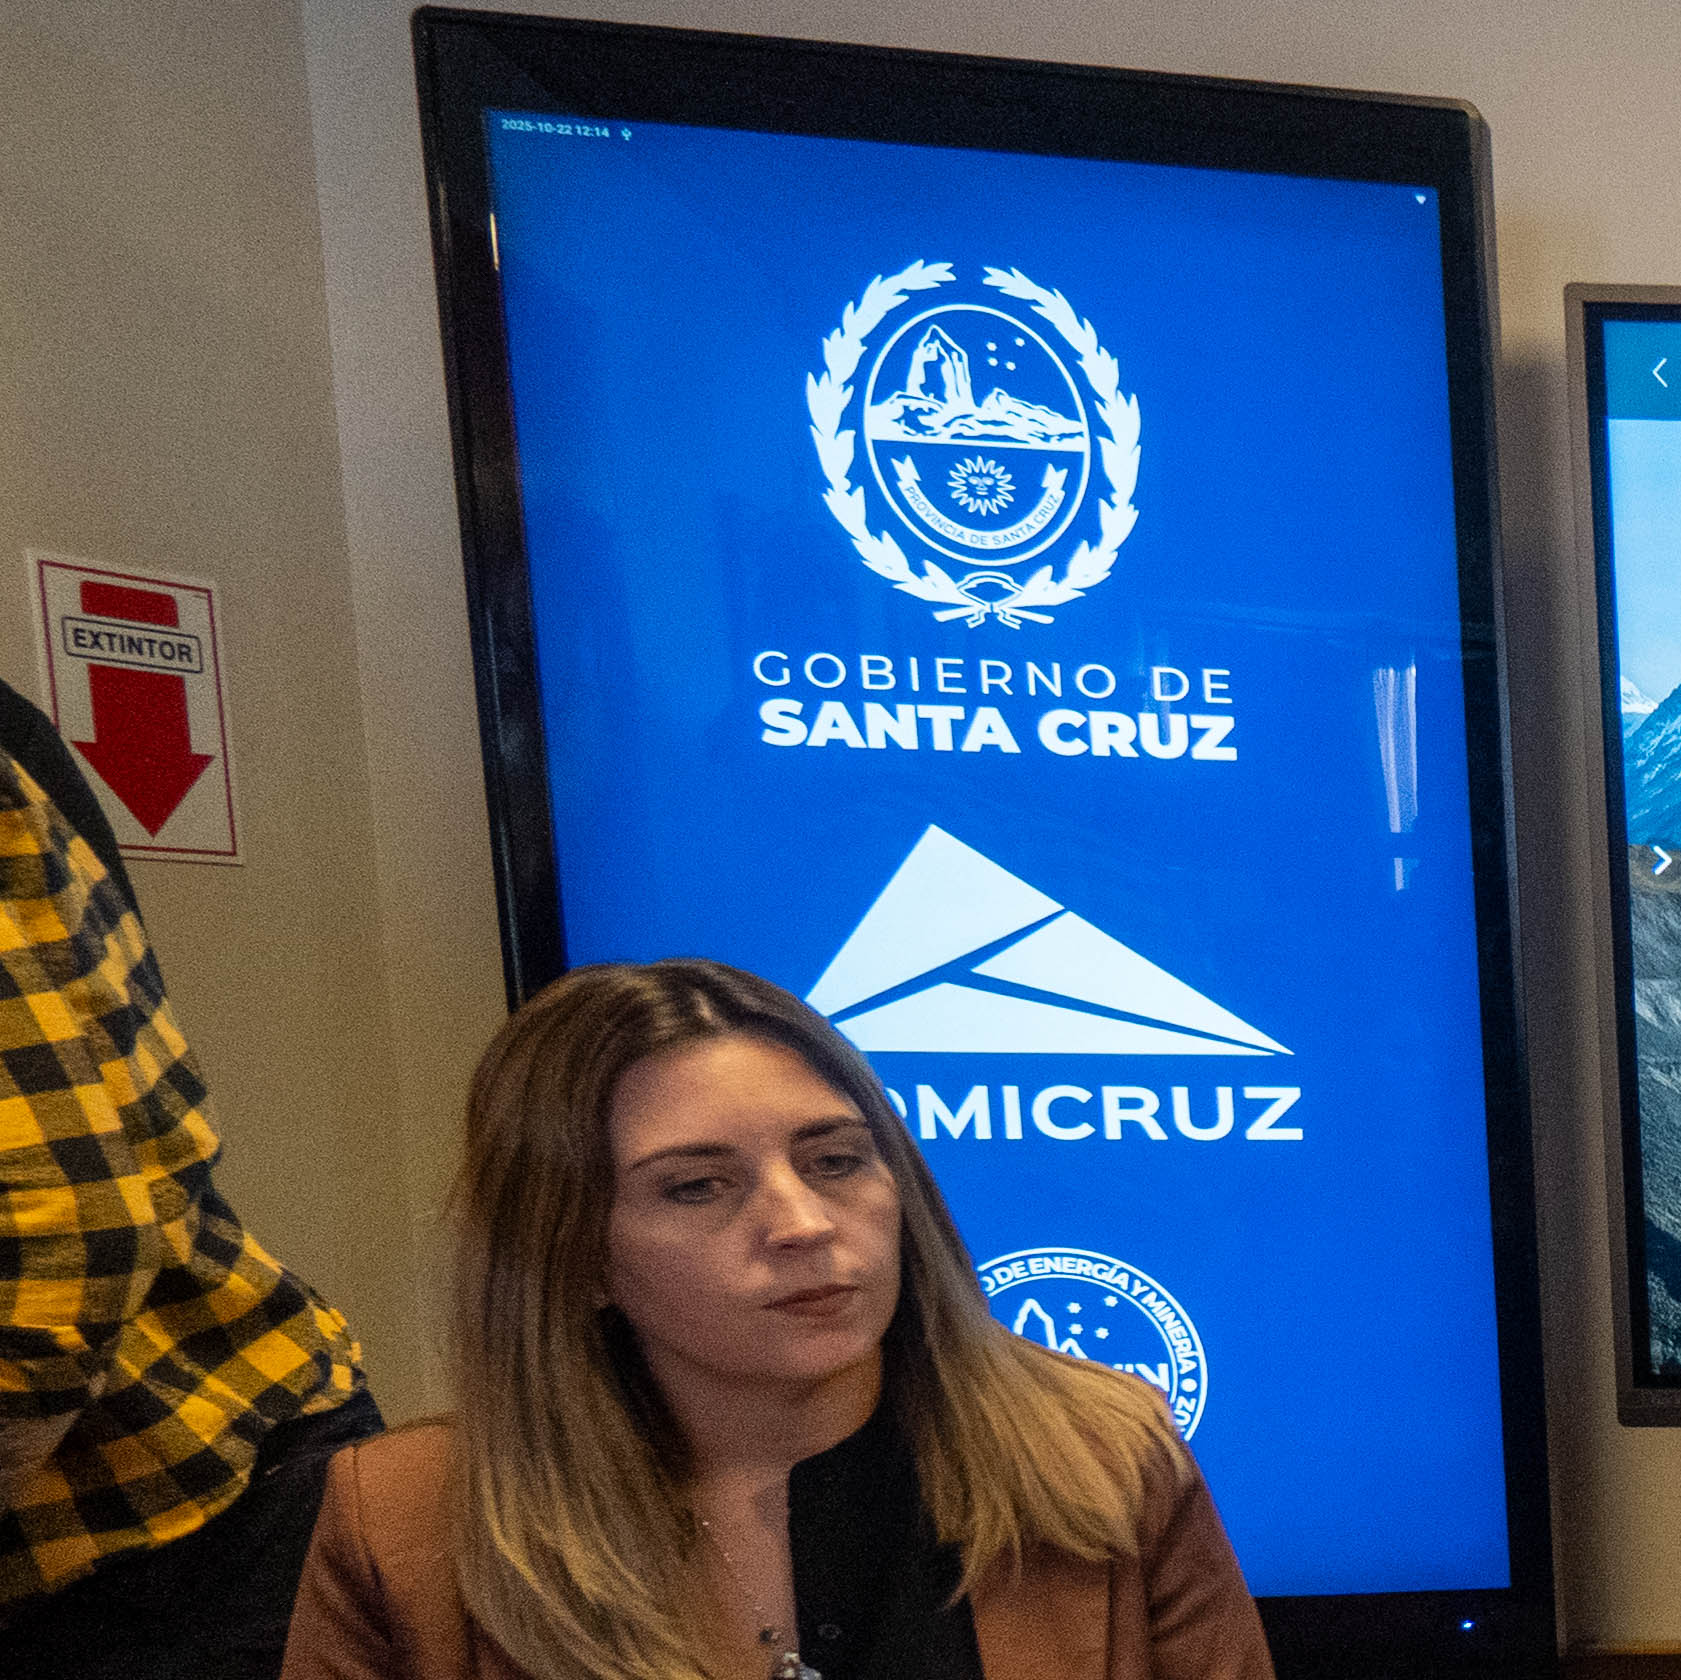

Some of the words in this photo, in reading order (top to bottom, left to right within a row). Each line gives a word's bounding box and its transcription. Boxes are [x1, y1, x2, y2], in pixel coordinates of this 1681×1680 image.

[502, 119, 573, 136] 2025-10-22
[575, 124, 609, 138] 12:14
[905, 486, 965, 540] PROVINCIA
[970, 534, 988, 546] DE
[992, 524, 1035, 545] SANTA
[1034, 493, 1059, 524] CRUZ
[73, 628, 192, 663] EXTINTOR
[752, 650, 1117, 698] GOBIERNO
[1152, 665, 1233, 704] DE
[758, 698, 1021, 754] SANTA
[1037, 708, 1238, 761] CRUZ
[884, 1084, 1303, 1141] MICRUZ
[992, 1260, 1030, 1285] DE
[1028, 1256, 1130, 1290] ENERGÍA
[1129, 1280, 1150, 1297] Y
[1141, 1291, 1200, 1374] MINERÍA
